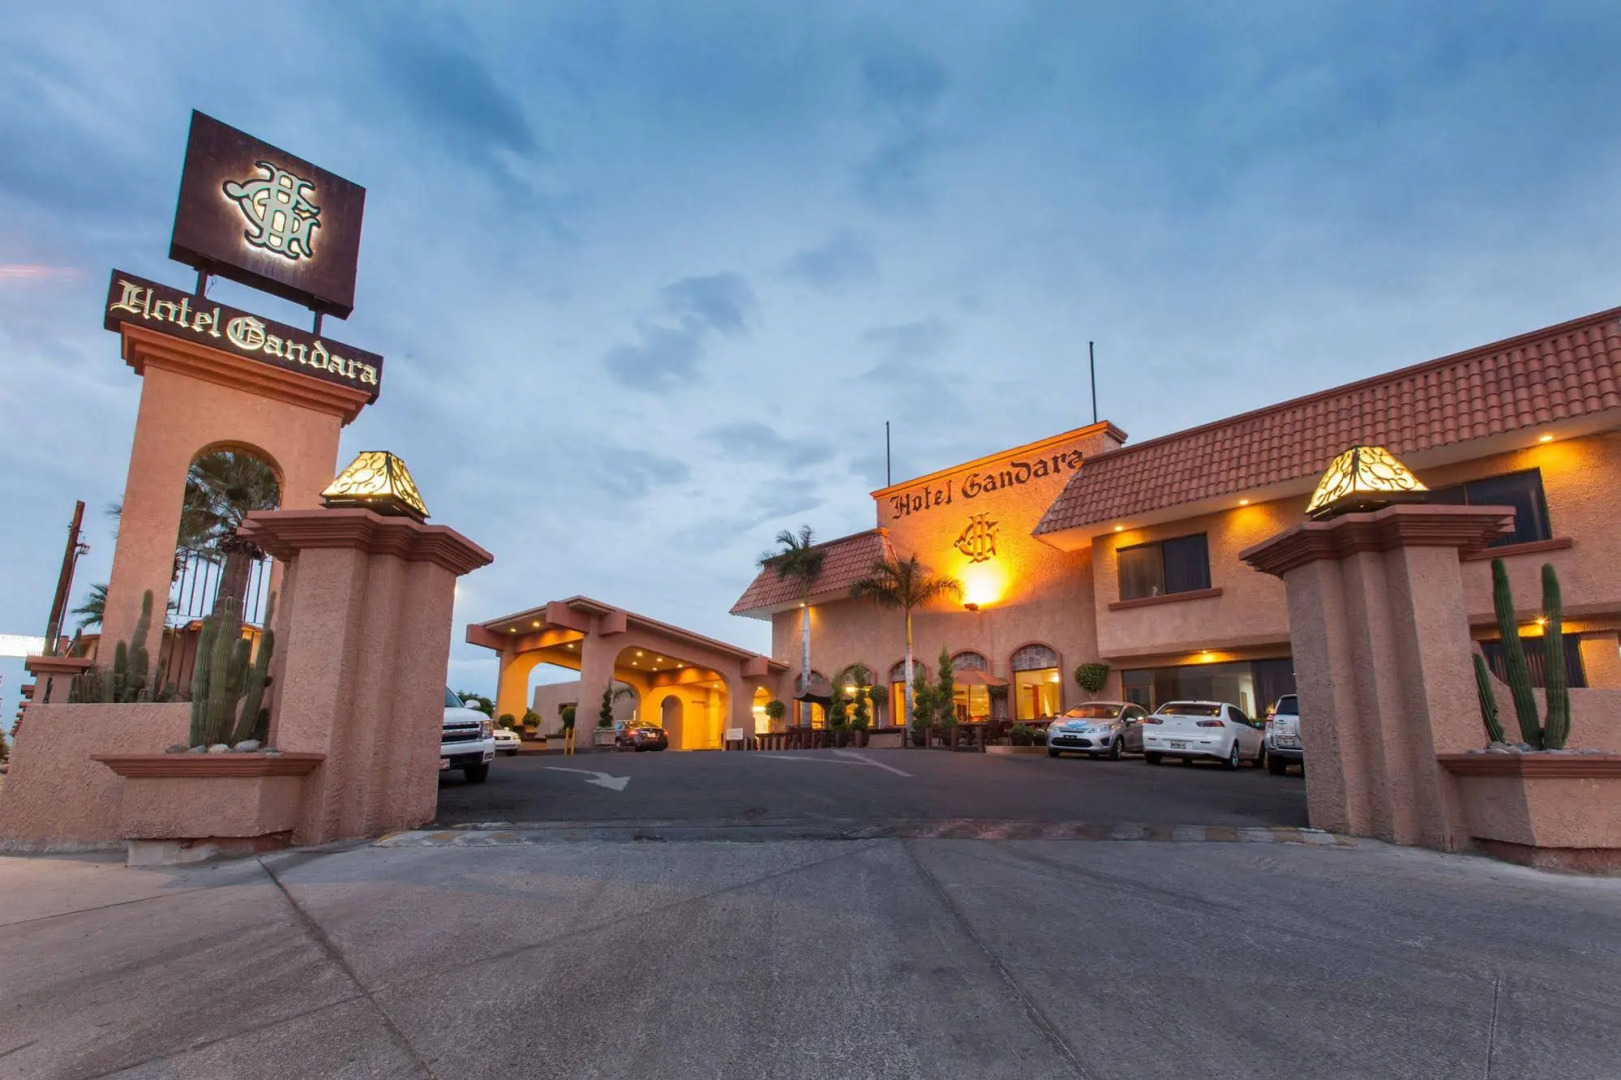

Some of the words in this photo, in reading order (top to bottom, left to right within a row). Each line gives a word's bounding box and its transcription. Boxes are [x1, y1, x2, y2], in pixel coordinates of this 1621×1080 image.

[110, 279, 222, 338] Hotel
[226, 316, 379, 386] Gandara
[889, 479, 952, 520] Hotel
[961, 449, 1084, 499] Gandara
